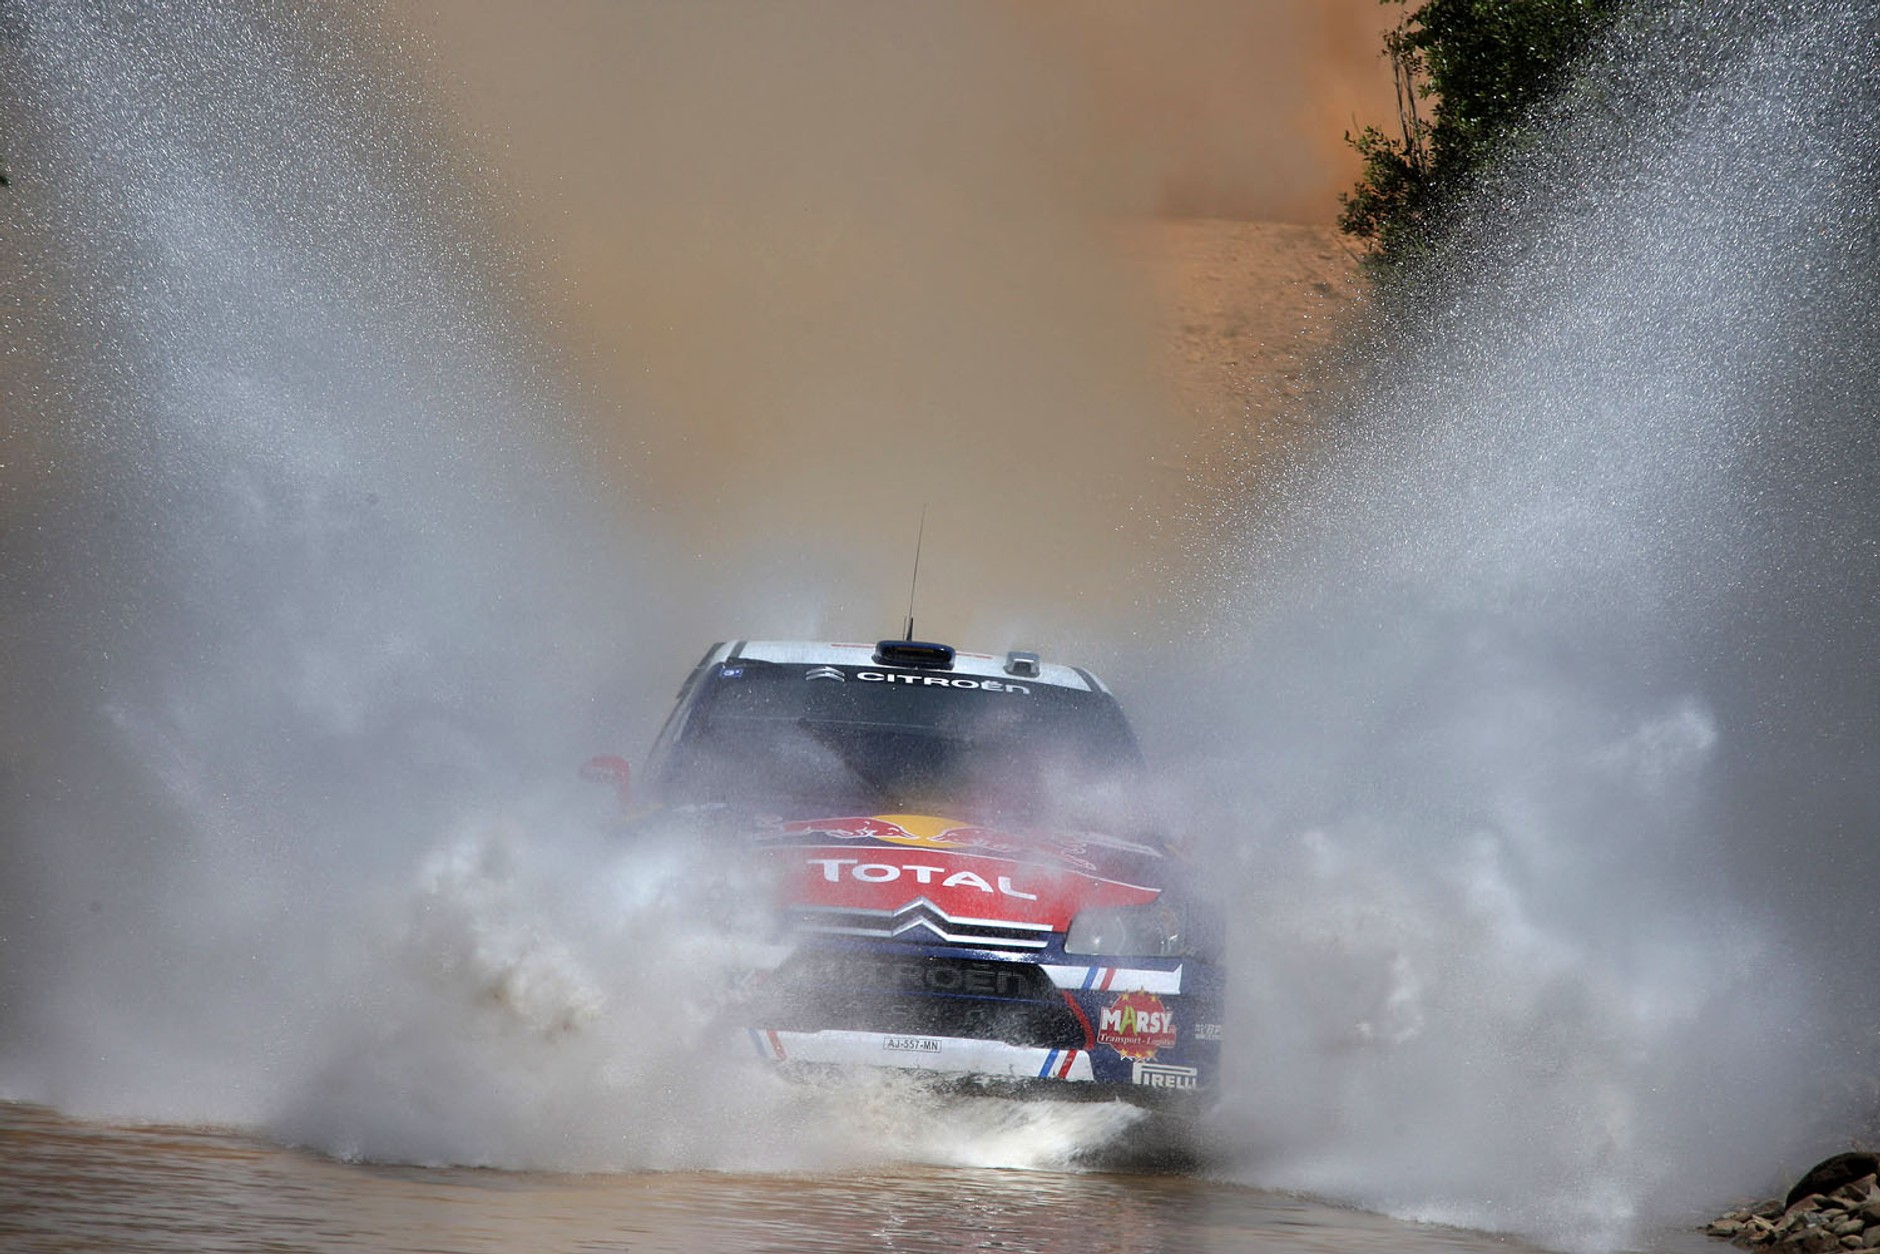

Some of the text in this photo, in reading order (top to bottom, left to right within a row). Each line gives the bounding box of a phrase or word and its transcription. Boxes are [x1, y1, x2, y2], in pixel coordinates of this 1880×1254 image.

[807, 859, 1038, 901] TOTAL
[1101, 1006, 1173, 1035] MARSY
[1132, 1061, 1198, 1089] PIRELLI
